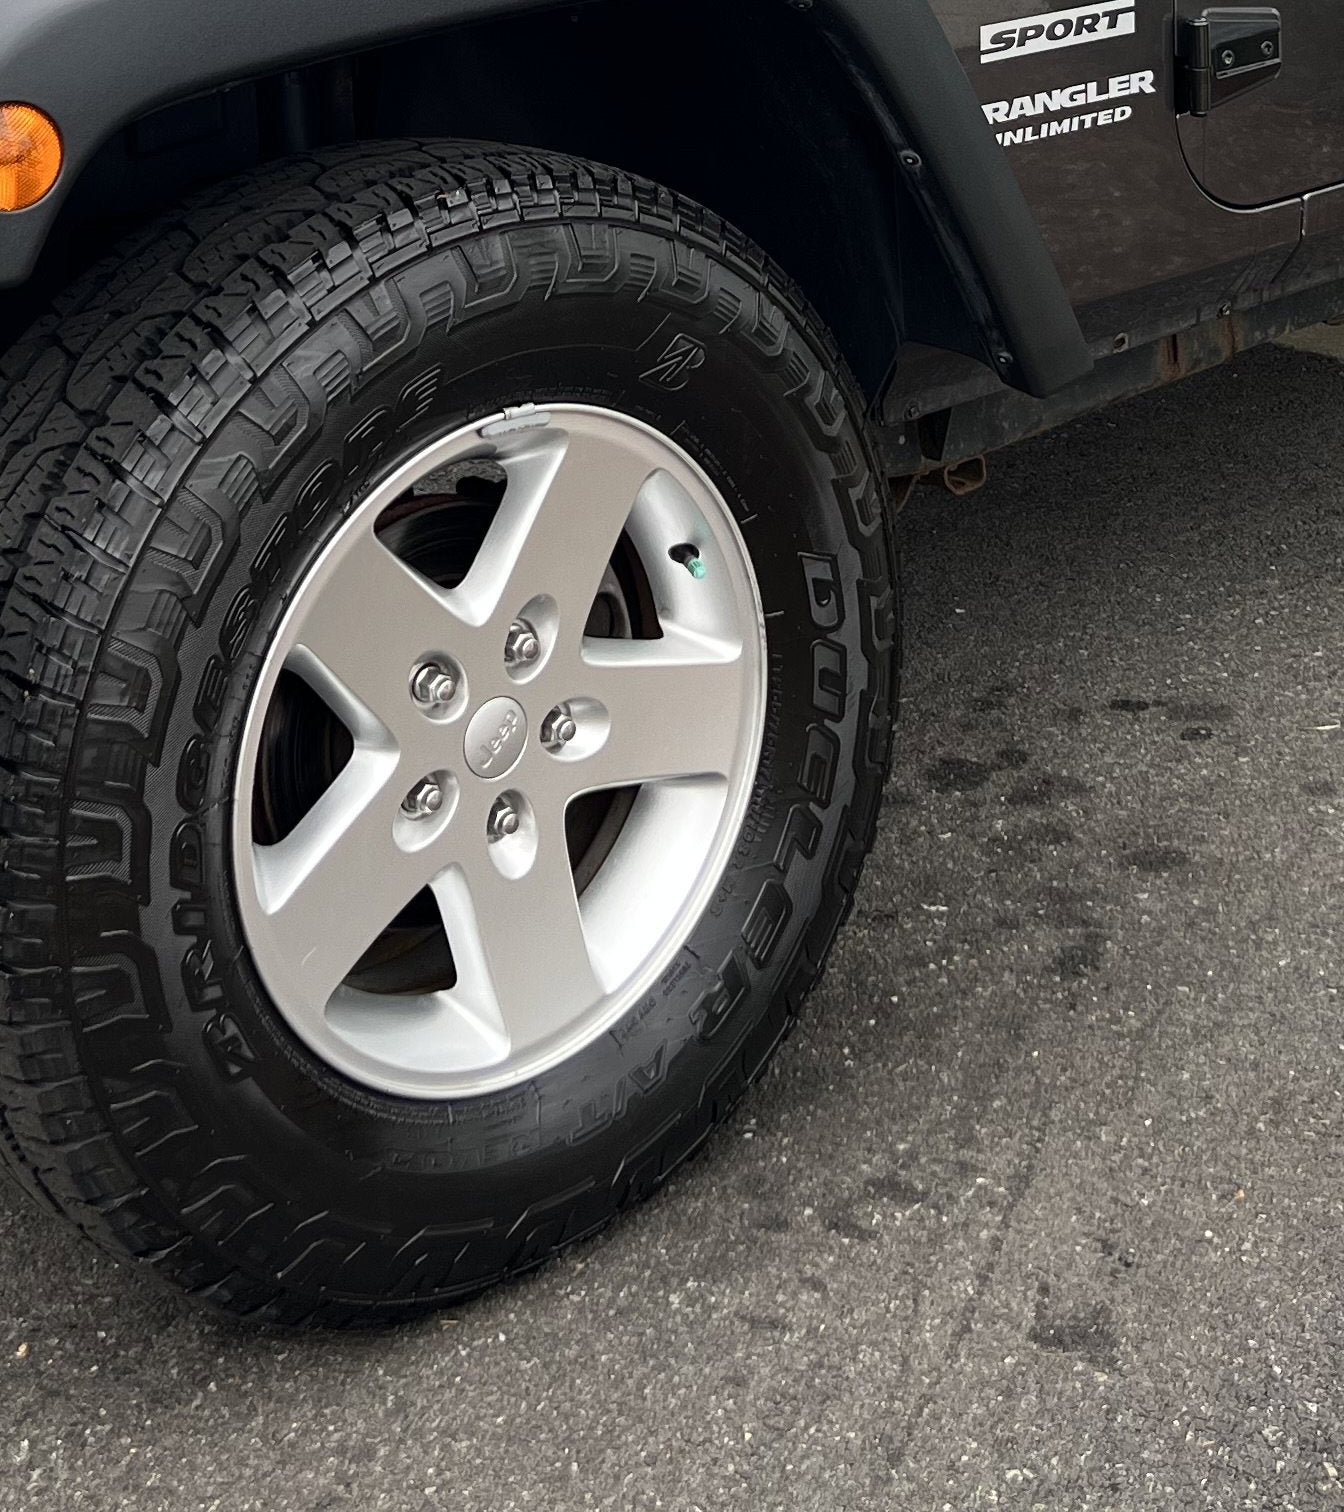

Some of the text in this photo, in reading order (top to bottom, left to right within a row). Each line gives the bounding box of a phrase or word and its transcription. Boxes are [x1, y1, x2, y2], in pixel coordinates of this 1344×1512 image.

[988, 8, 1133, 53] SPORT
[980, 70, 1156, 125] RANGLER
[170, 361, 445, 1082] BRIDGESTONE
[479, 708, 518, 769] Jeep
[688, 550, 848, 1039] DUELER
